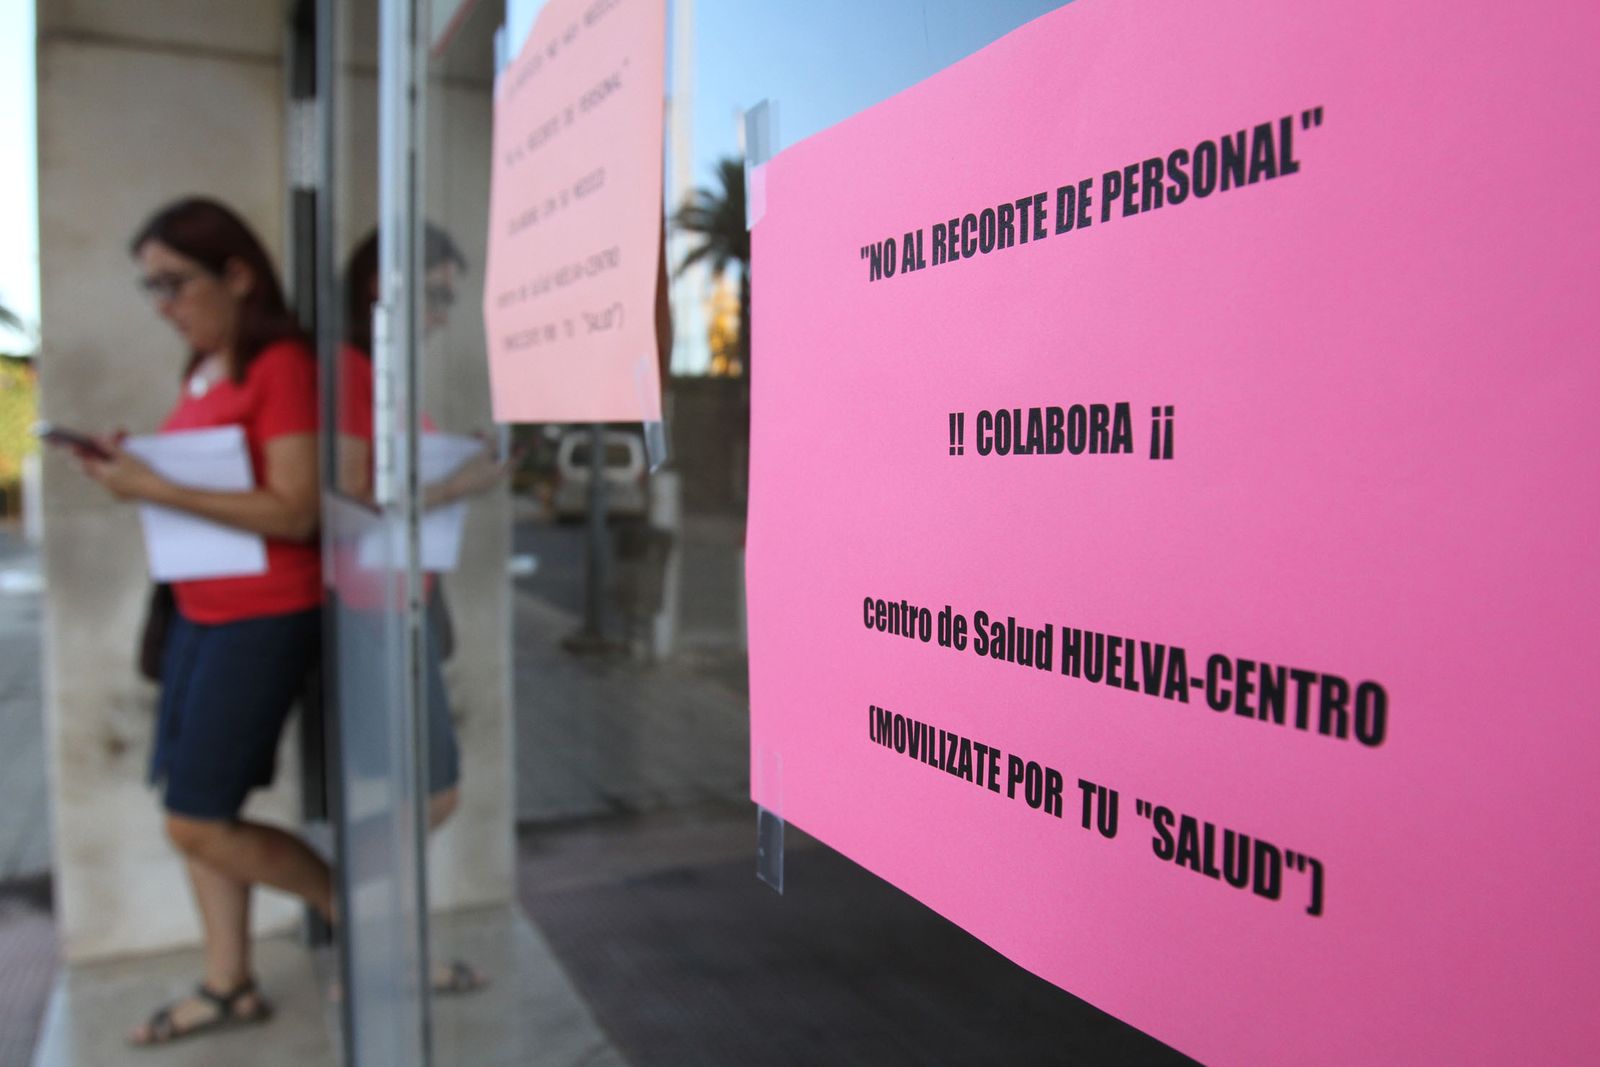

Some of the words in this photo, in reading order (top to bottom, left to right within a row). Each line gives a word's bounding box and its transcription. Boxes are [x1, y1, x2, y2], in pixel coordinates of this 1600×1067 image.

[861, 237, 897, 282] "NO
[901, 229, 926, 274] AL
[931, 192, 1048, 266] RECORTE
[1056, 178, 1093, 235] DE
[1101, 107, 1324, 223] PERSONAL"
[949, 412, 965, 456] !!
[976, 402, 1133, 456] COLABORA
[863, 596, 932, 643] centro
[938, 605, 968, 650] de
[973, 610, 1053, 671] Salud
[1062, 626, 1388, 748] HUELVA-CENTRO
[869, 705, 1001, 794] (MOVILIZATE
[1007, 754, 1063, 819] POR
[1078, 779, 1119, 839] TU
[1136, 799, 1324, 917] "SALUD")
